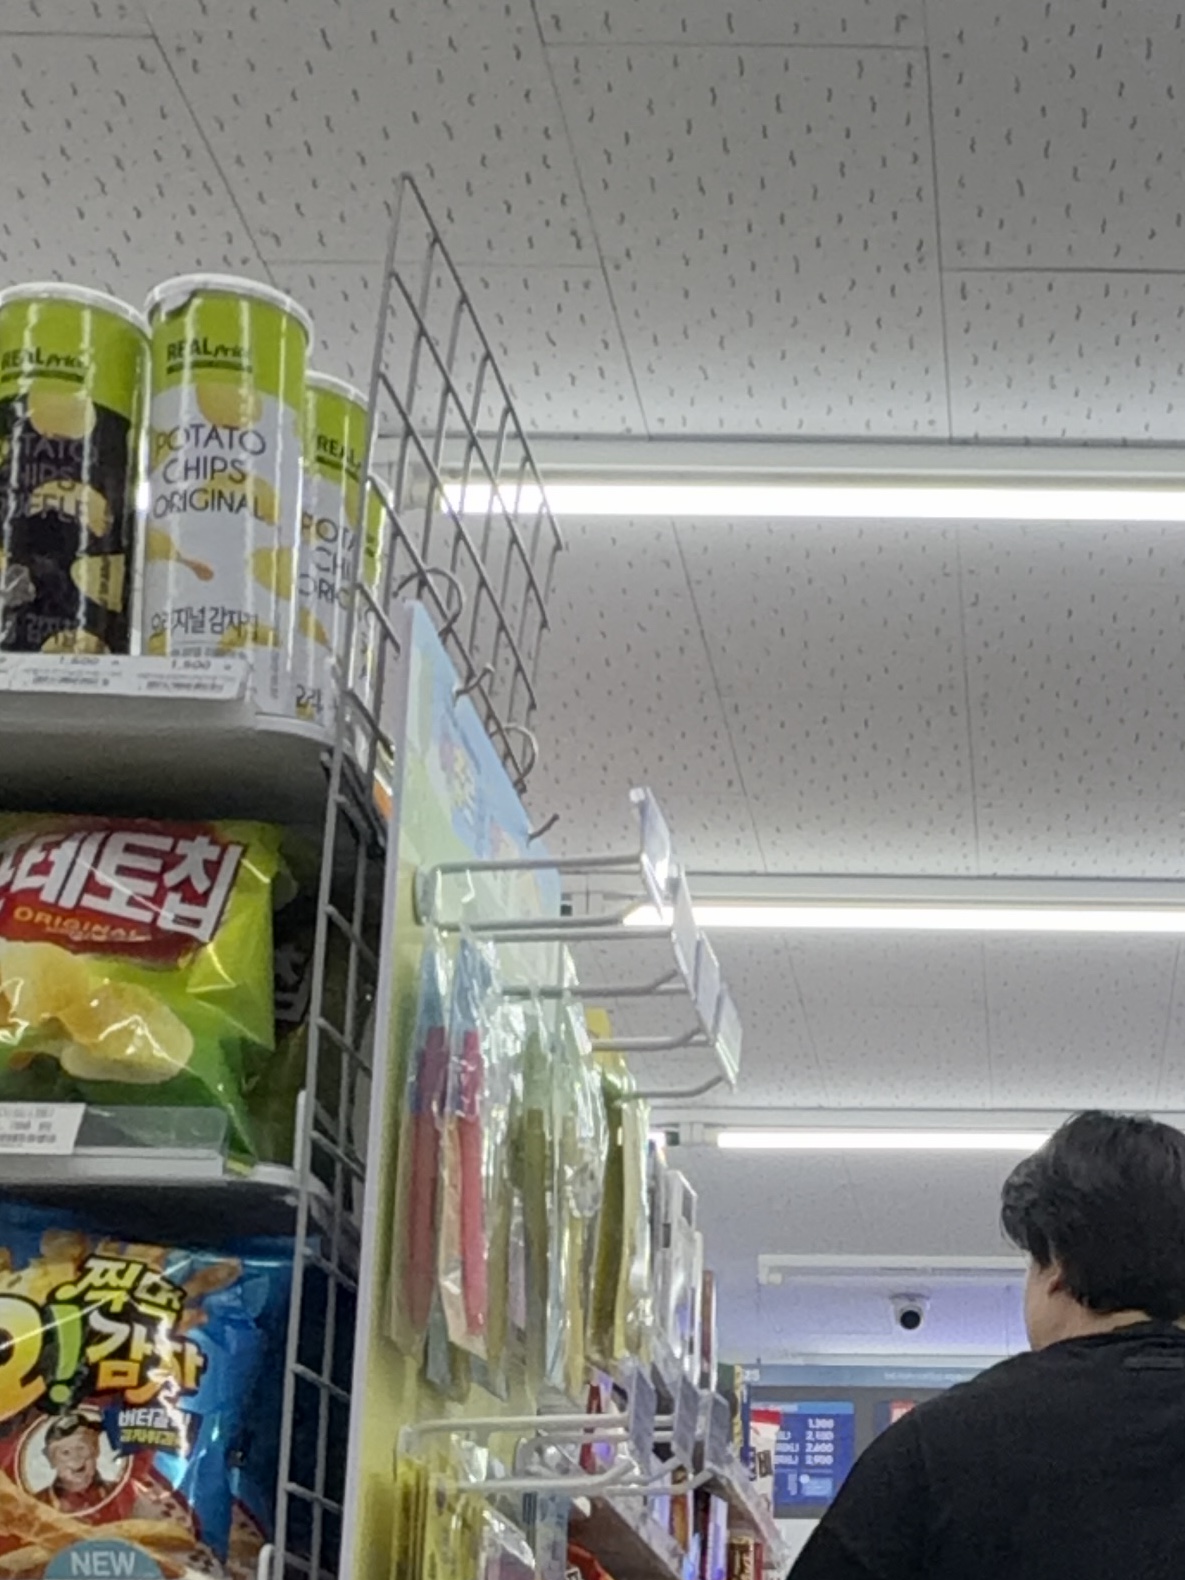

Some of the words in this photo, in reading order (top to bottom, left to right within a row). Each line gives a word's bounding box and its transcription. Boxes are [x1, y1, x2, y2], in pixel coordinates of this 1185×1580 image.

[154, 423, 267, 460] POTATO
[162, 454, 247, 485] CHIPS
[152, 486, 266, 520] ORIGINAL
[0, 829, 244, 943] 테토칩
[12, 905, 145, 941] ORIGINAL
[54, 1254, 187, 1319] 찍먹
[71, 1551, 136, 1577] NEW
